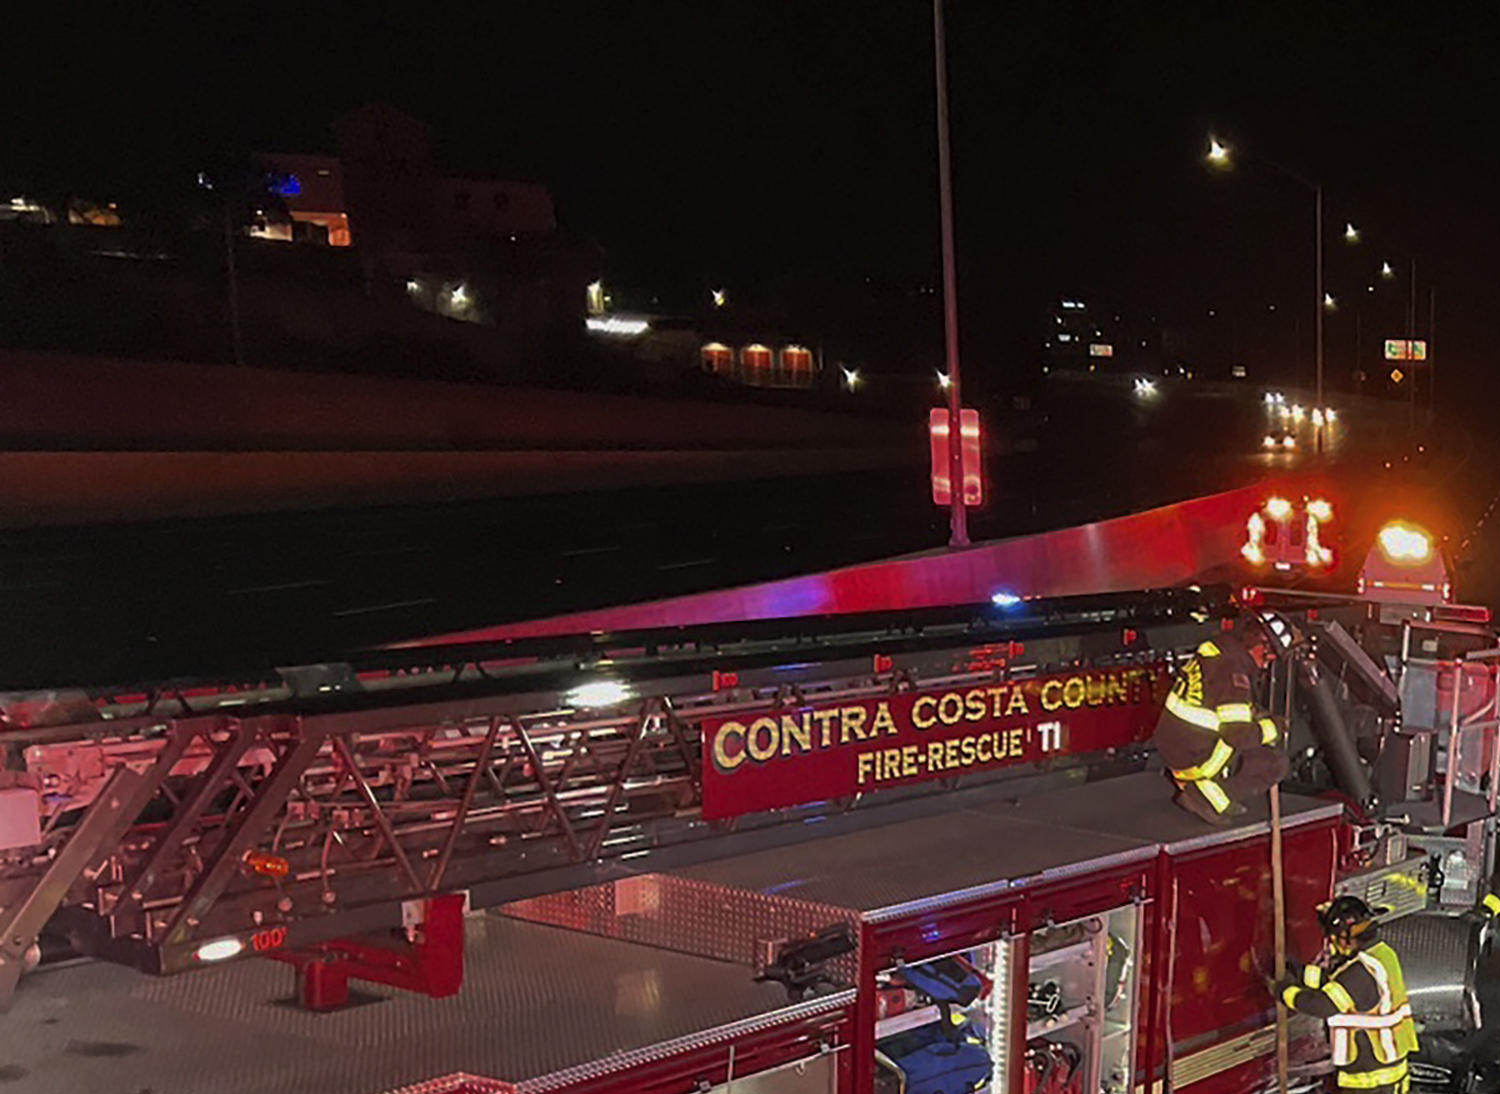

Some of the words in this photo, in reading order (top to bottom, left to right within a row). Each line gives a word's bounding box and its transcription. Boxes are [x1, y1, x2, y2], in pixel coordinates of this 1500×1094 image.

[714, 702, 898, 770] CONTRA
[912, 686, 1029, 730] COSTA
[857, 728, 1024, 785] FIRE-RESCUE
